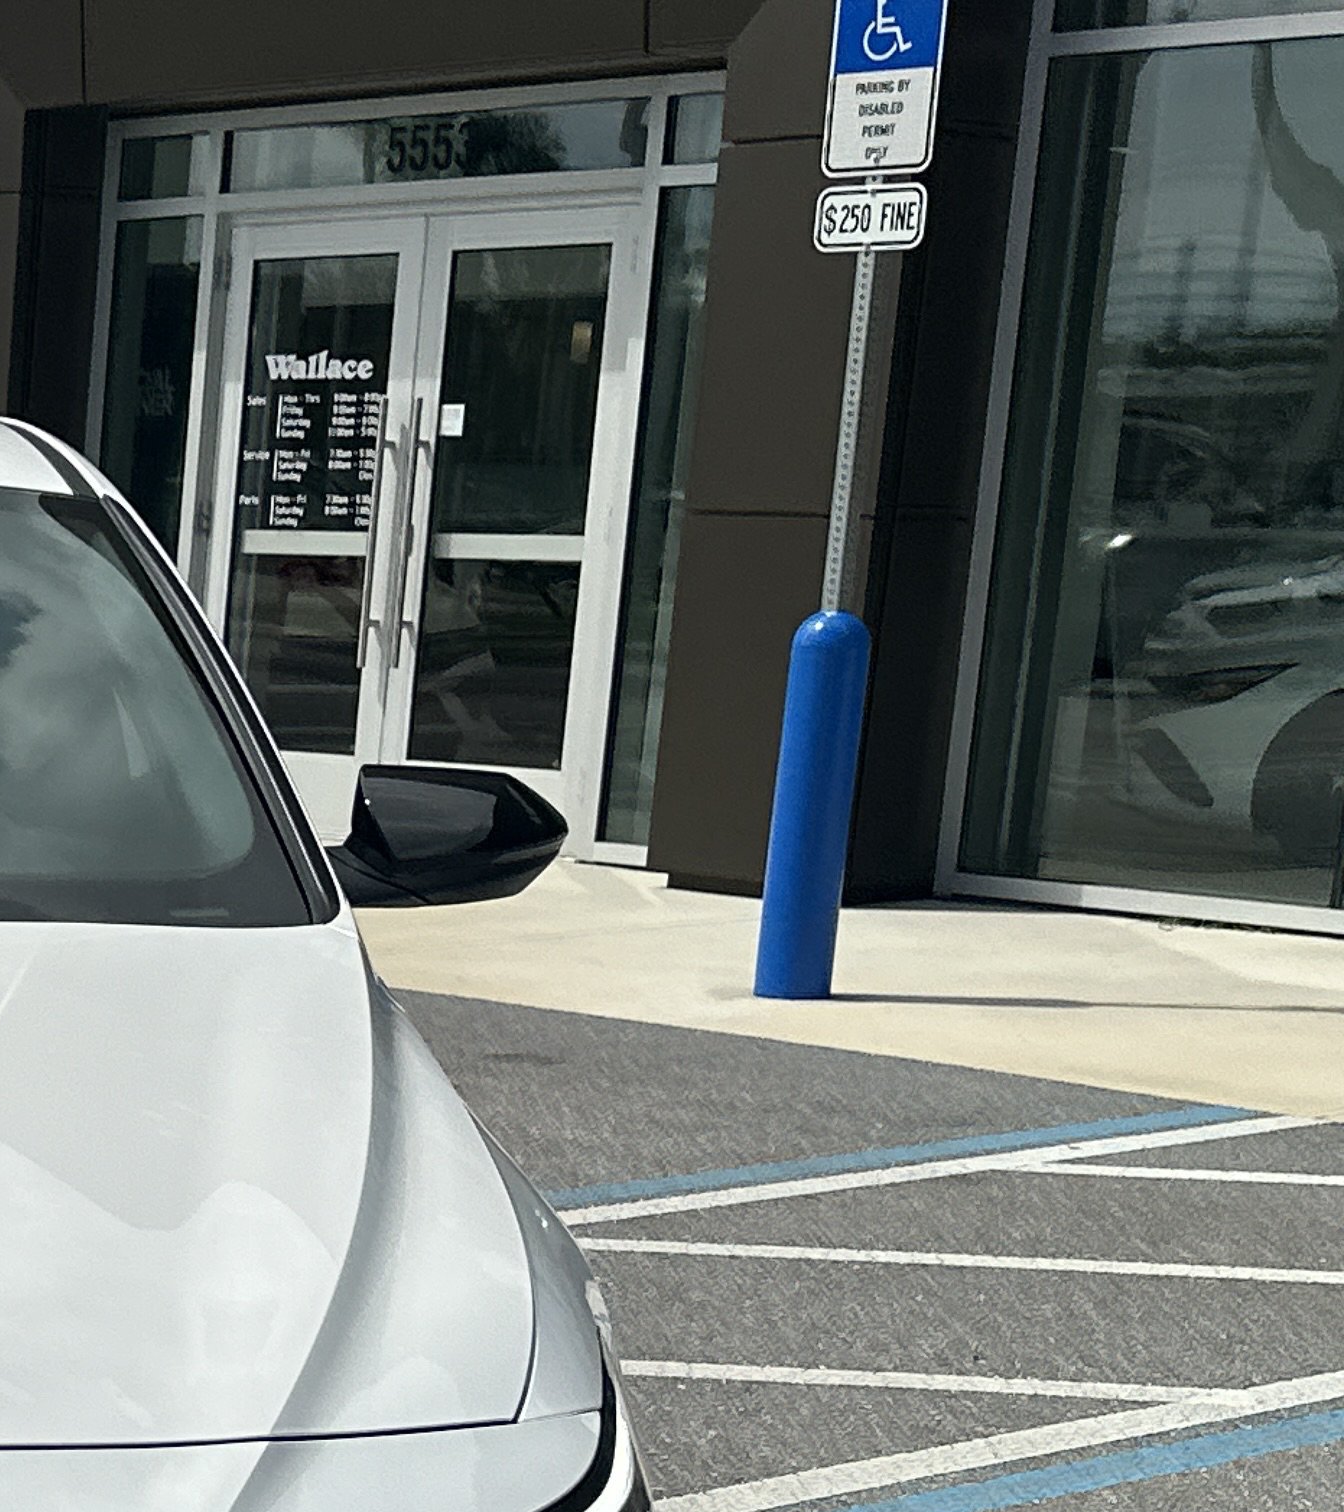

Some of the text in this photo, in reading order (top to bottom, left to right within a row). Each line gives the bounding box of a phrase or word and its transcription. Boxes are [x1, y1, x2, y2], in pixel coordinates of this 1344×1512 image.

[855, 78, 911, 96] PARKING BY
[858, 101, 904, 117] DISABLED
[862, 123, 896, 138] PERMIT
[824, 202, 917, 236] $250 FINE
[264, 349, 374, 380] Wallace
